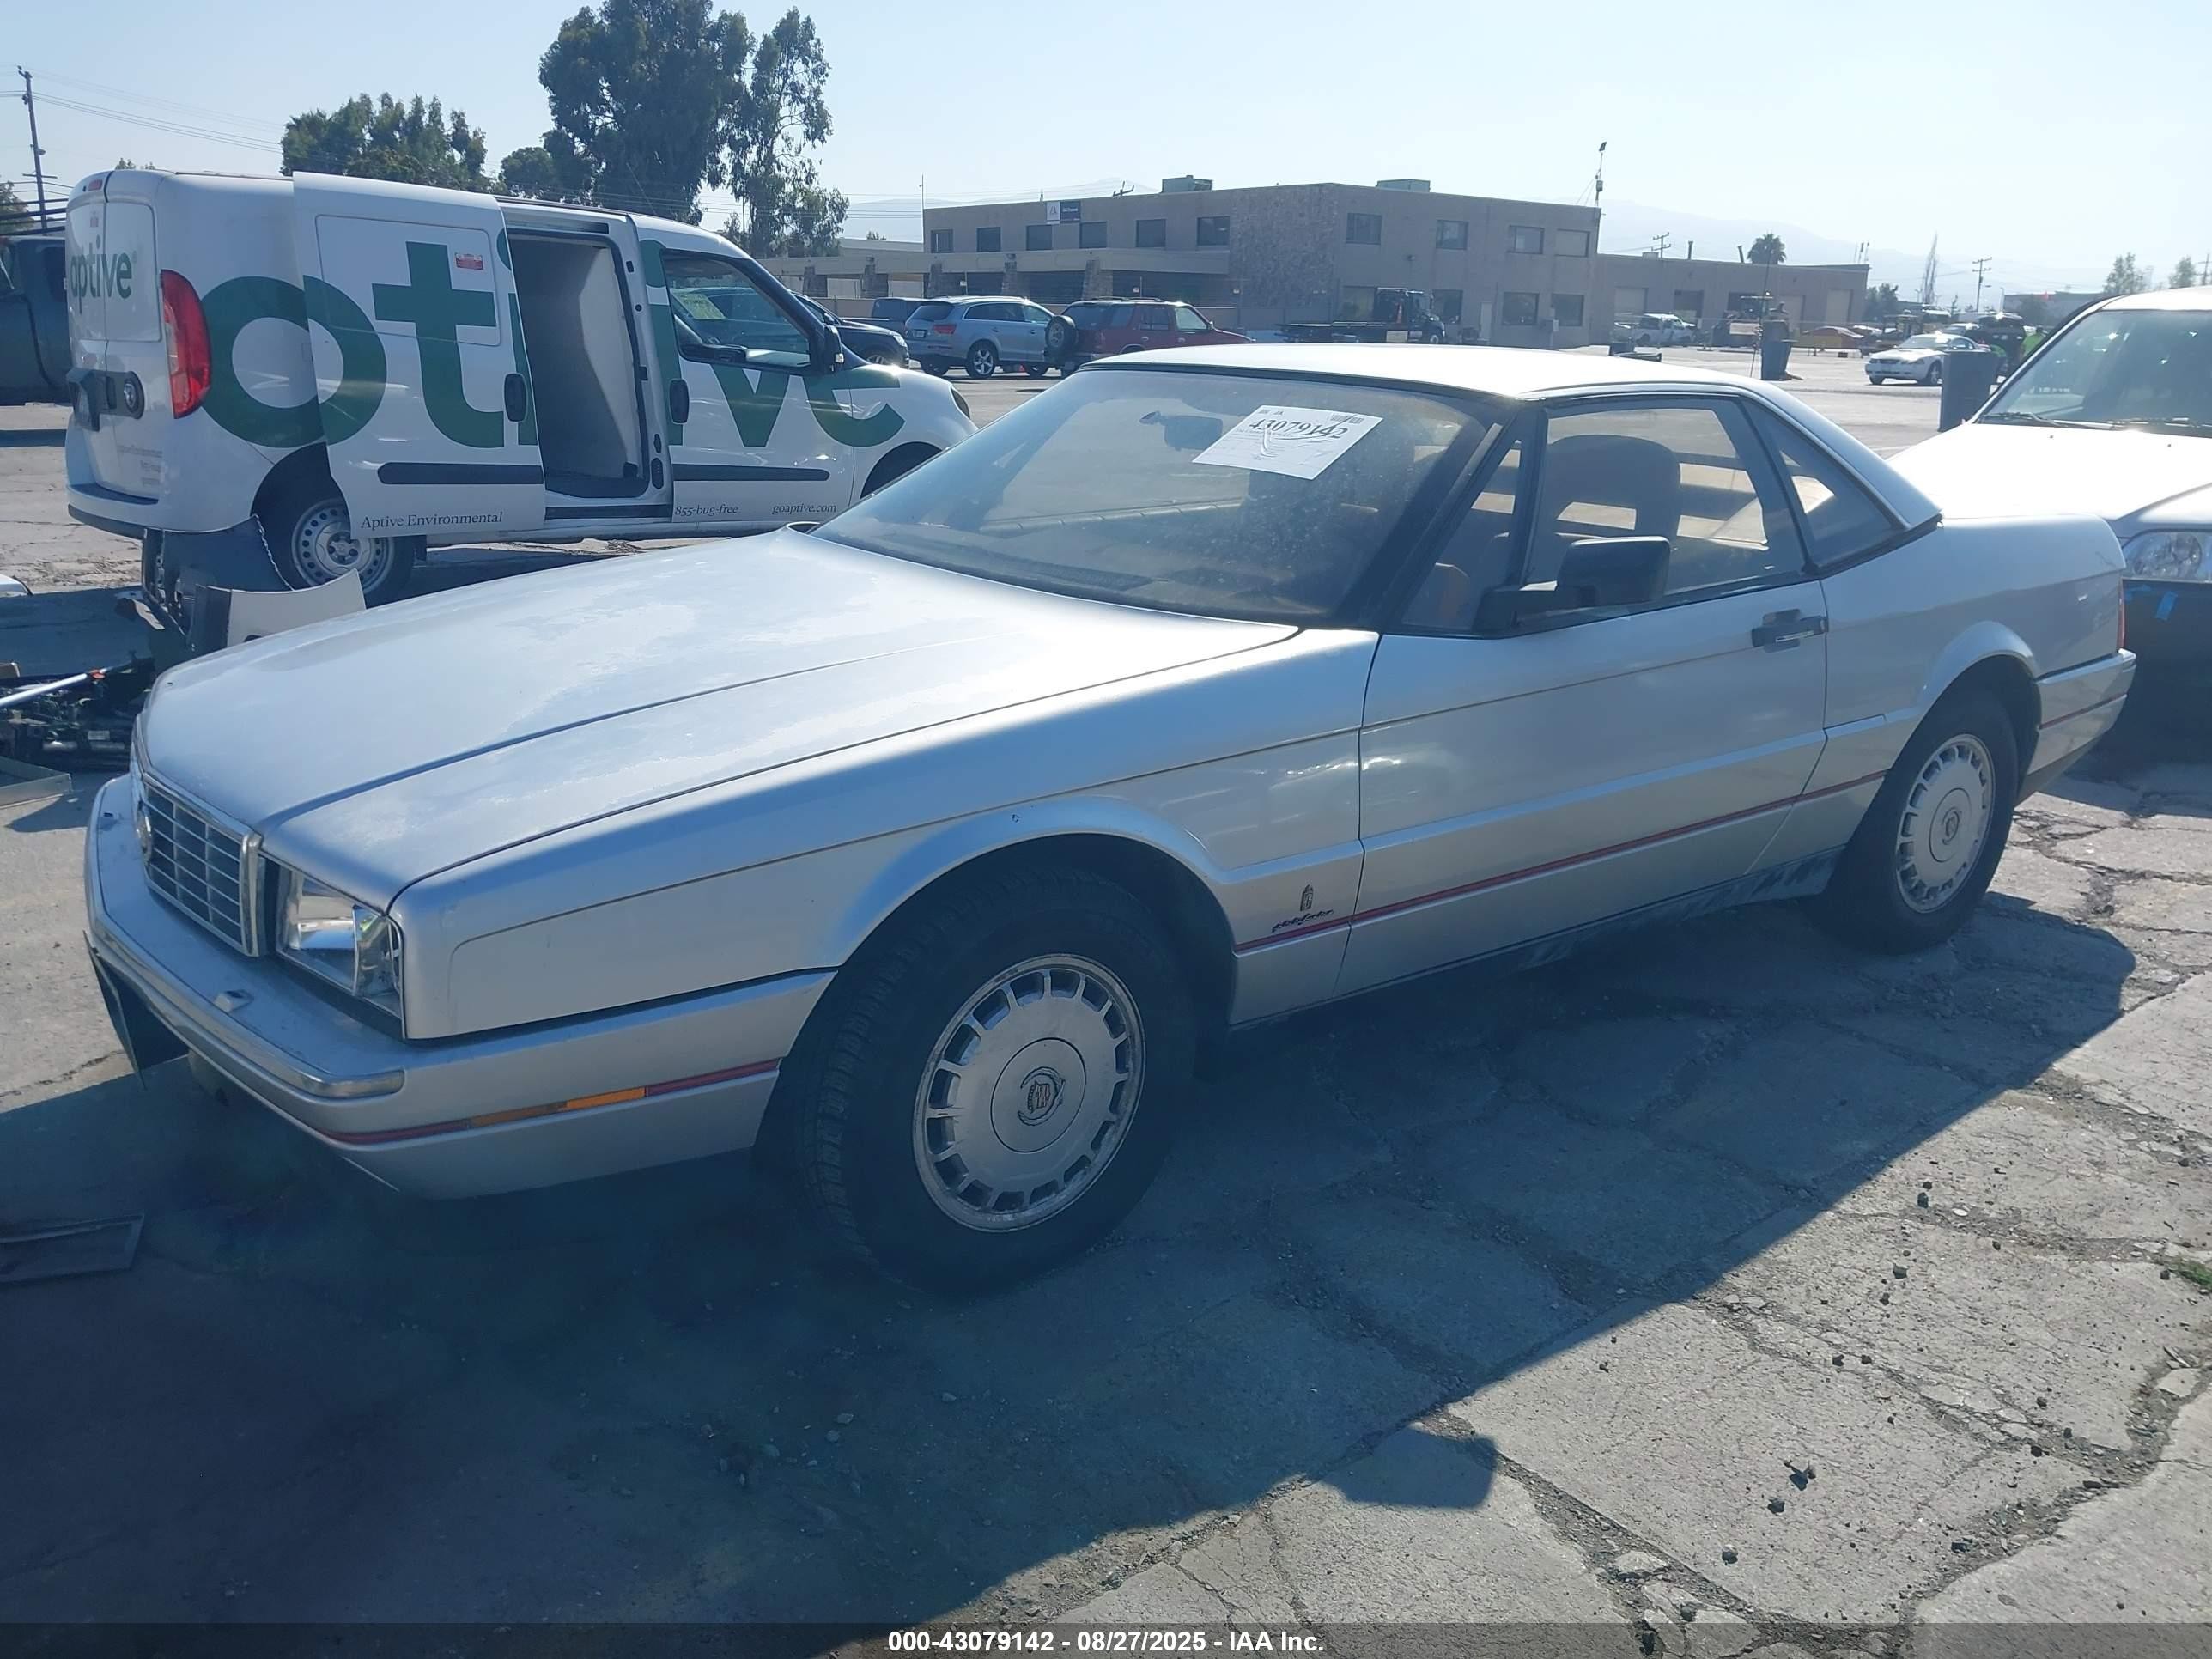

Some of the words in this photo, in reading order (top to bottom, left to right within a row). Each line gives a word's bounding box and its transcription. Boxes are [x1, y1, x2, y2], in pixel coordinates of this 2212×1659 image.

[1249, 418, 1348, 439] 43079142
[675, 504, 739, 516] 855-bug-free
[772, 502, 836, 515] goaptive.com
[361, 516, 404, 531] Aptive
[407, 511, 503, 526] Environmental
